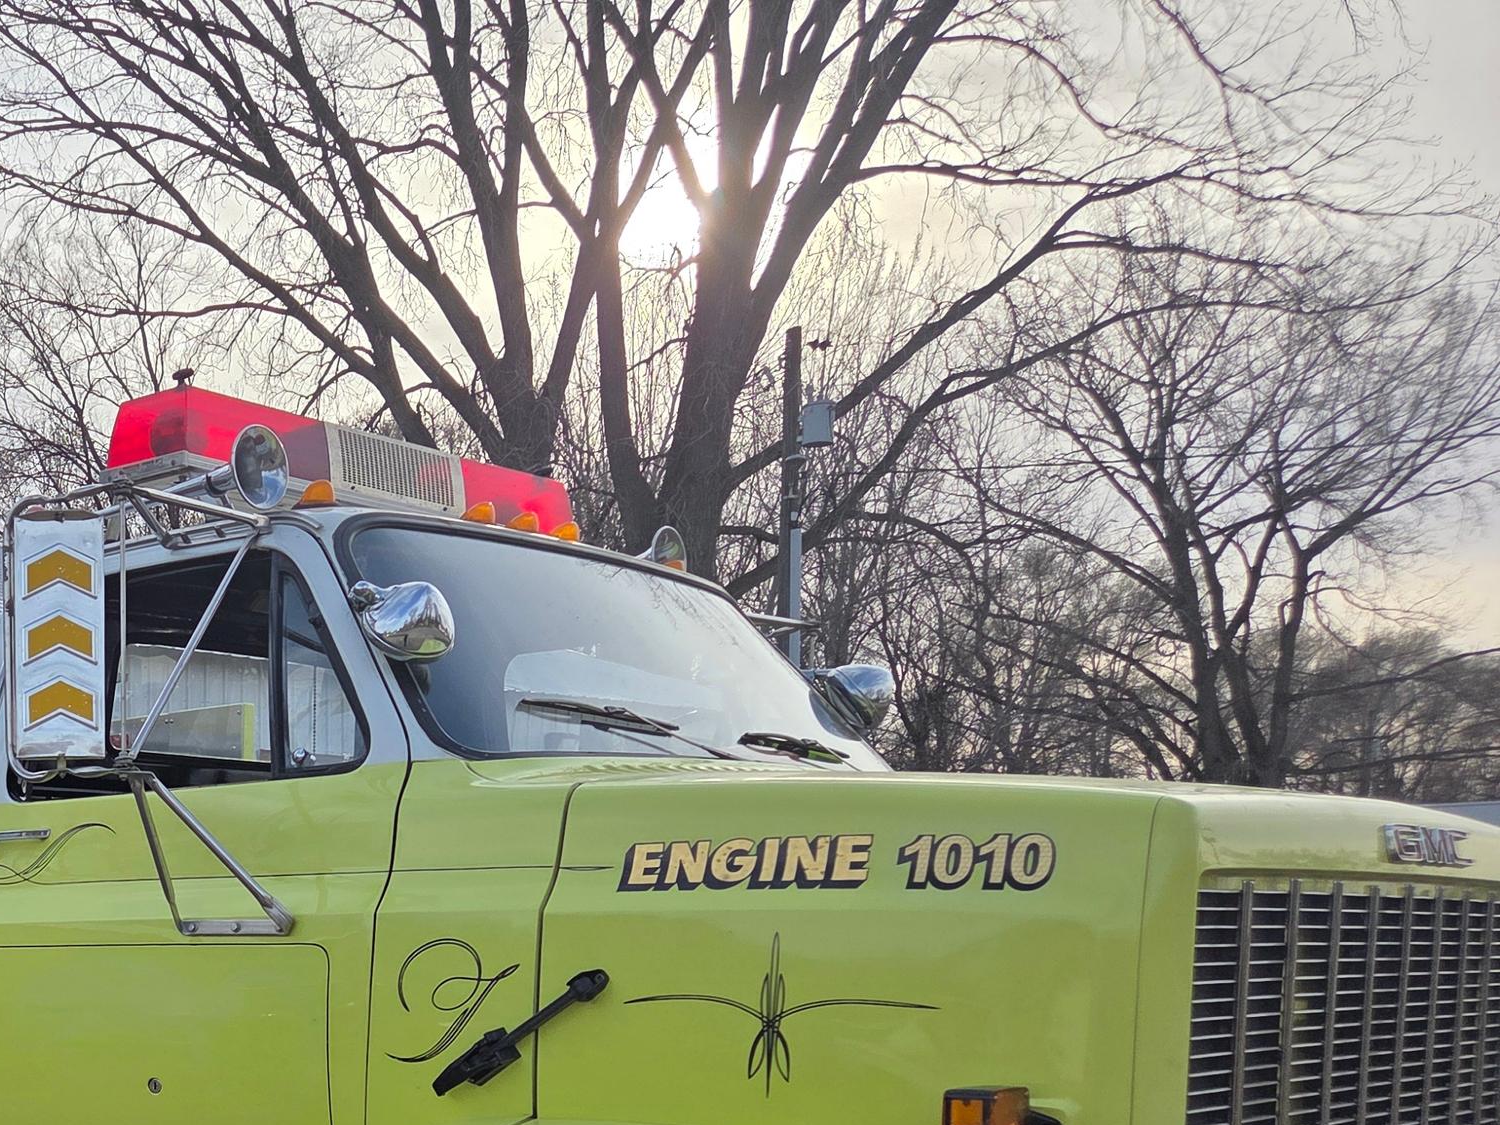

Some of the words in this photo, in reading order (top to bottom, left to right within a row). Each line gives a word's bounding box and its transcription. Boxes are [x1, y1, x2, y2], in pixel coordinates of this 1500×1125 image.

[618, 834, 874, 892] ENGINE
[898, 833, 1056, 891] 1010
[1381, 823, 1475, 867] GMC
